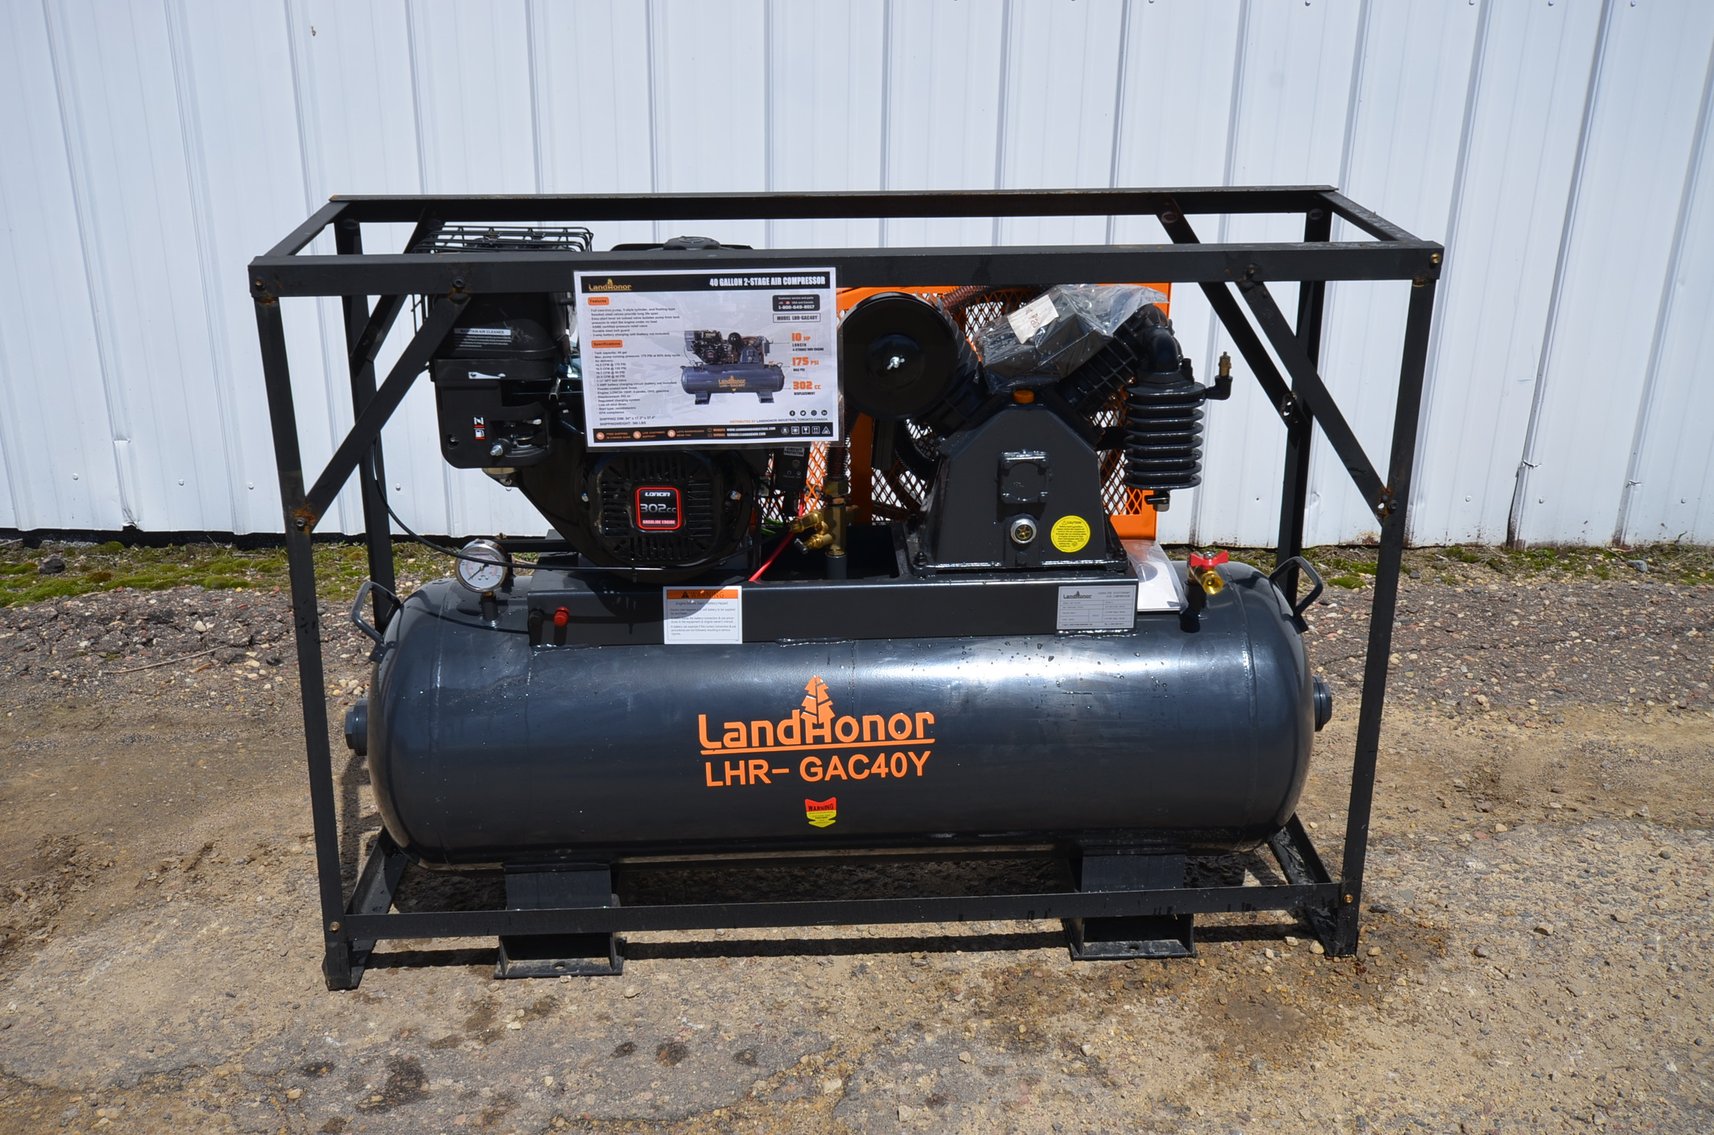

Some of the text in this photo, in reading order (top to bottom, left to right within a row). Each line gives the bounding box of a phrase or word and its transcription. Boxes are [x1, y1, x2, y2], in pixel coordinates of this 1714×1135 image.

[588, 280, 632, 290] LandHonor
[709, 276, 825, 287] 40 GALLON 2-STAGE AIR COMPRESSOR
[792, 333, 801, 341] 10
[792, 357, 809, 366] 175
[793, 381, 812, 390] 302
[640, 504, 676, 513] 302cc
[698, 688, 936, 749] LandHonor
[705, 750, 932, 787] LHR- GAC40Y
[809, 803, 833, 811] WARNING
